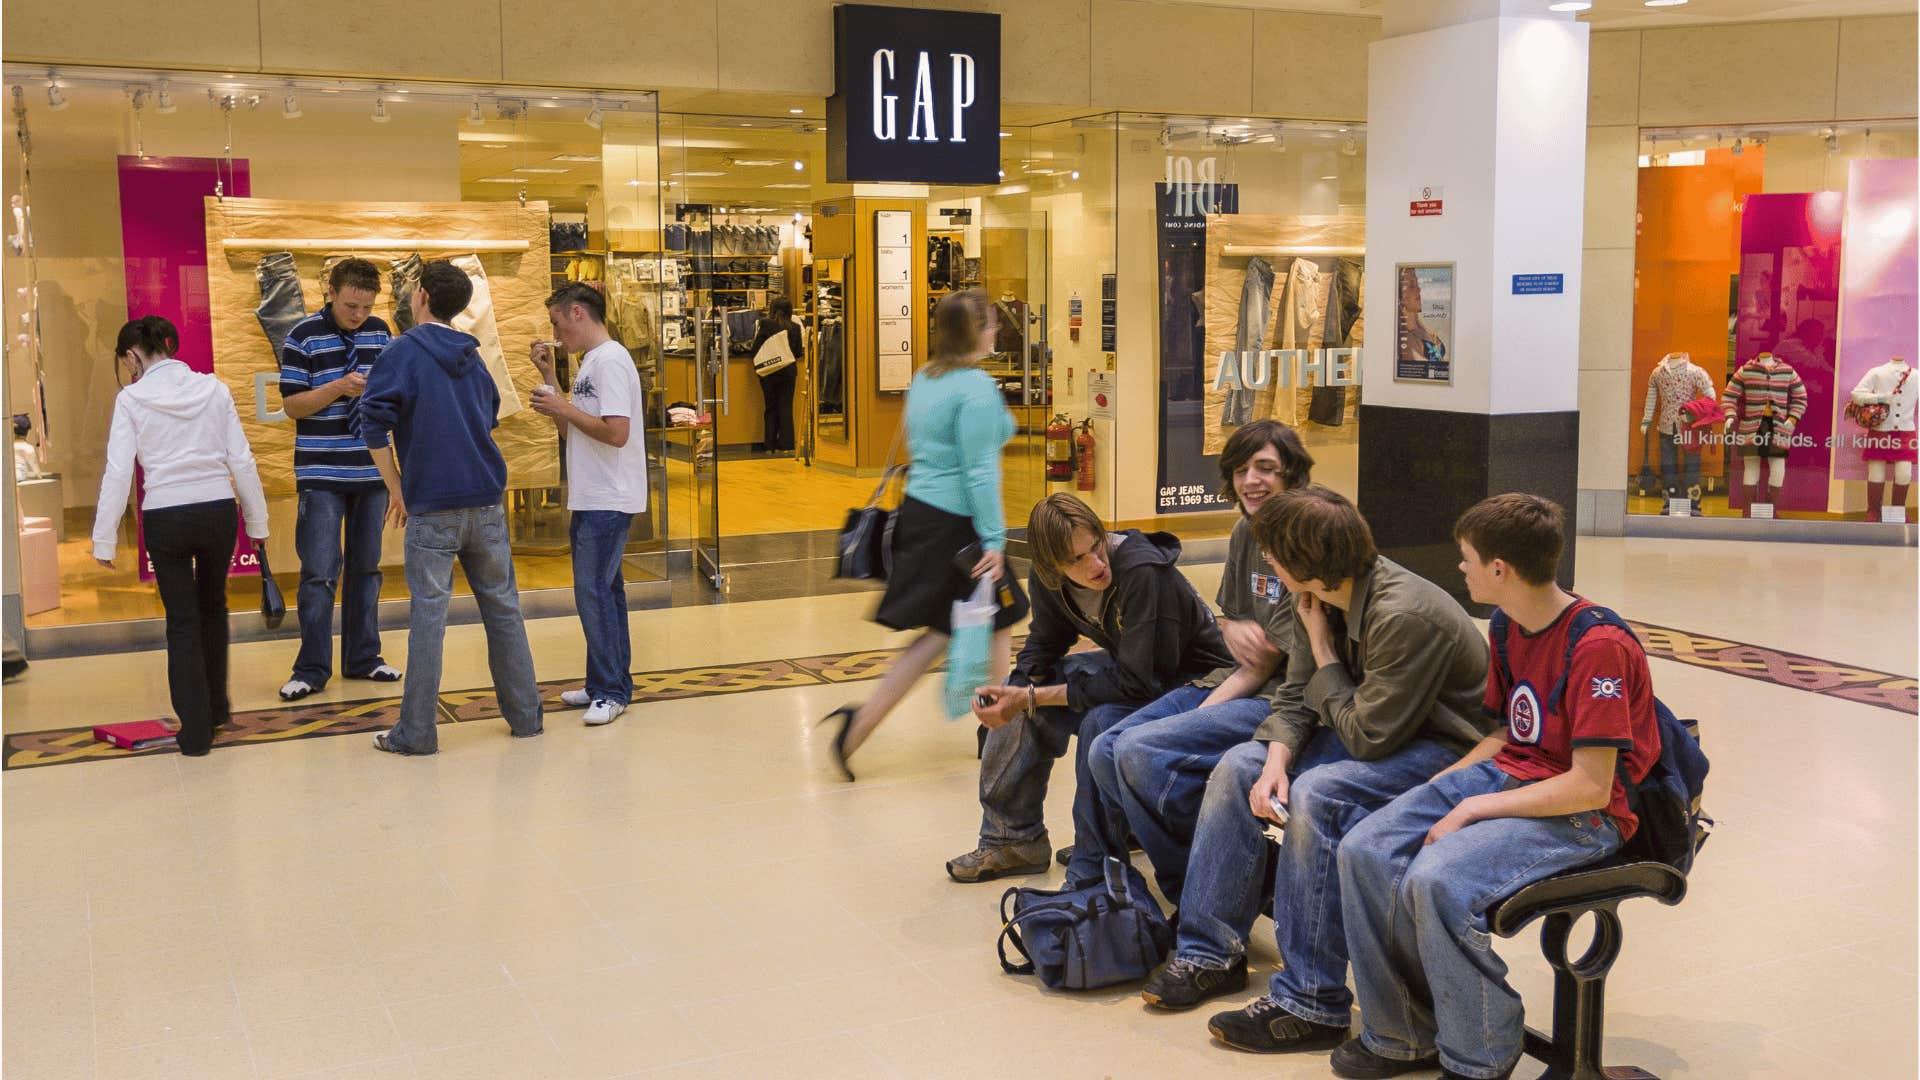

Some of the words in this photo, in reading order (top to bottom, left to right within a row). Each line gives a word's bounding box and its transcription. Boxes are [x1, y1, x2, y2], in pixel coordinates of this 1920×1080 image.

[873, 48, 975, 142] GAP
[902, 233, 908, 245] 1
[902, 270, 908, 281] 1
[902, 305, 909, 316] 0
[902, 340, 909, 352] 0
[1673, 430, 1692, 445] all
[1699, 430, 1746, 447] kinds
[1752, 431, 1772, 447] of
[1776, 432, 1818, 448] kids.
[1825, 434, 1845, 448] all
[1852, 434, 1902, 449] kinds
[1160, 487, 1177, 496] GAP
[1178, 485, 1205, 495] JEANS
[1160, 497, 1177, 507] EST.
[1180, 495, 1201, 506] 1969
[1203, 495, 1215, 504] SF.
